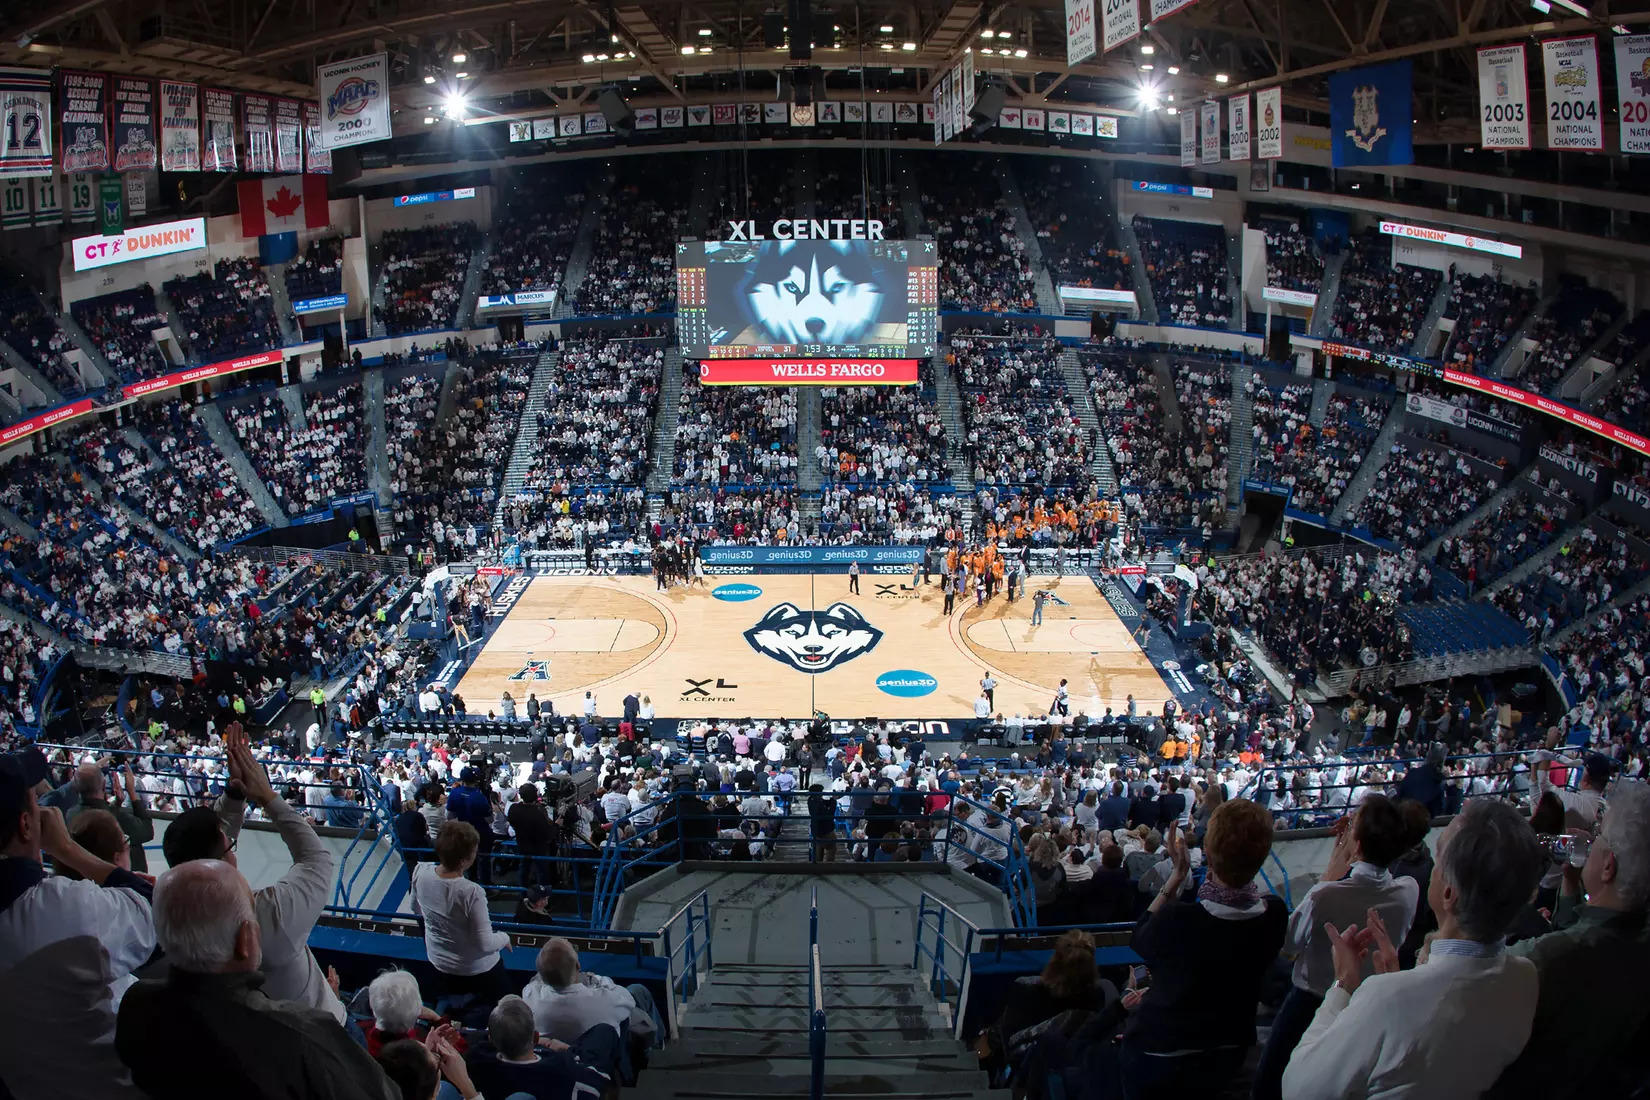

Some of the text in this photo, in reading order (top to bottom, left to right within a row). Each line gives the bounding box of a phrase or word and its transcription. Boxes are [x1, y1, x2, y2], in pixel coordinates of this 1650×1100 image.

[1106, 0, 1131, 15] 20
[1069, 4, 1090, 36] 2014
[1108, 9, 1132, 28] NATIONAL
[1107, 22, 1136, 44] CHAMPIONS
[324, 60, 381, 78] UCONN HOCKEY
[68, 100, 97, 111] SEASON
[327, 80, 380, 121] MAAC
[63, 112, 104, 123] CHAMPIONS
[120, 114, 149, 124] CHAMPIONS
[1485, 104, 1524, 122] 2003
[1551, 101, 1597, 120] 2004
[1623, 102, 1650, 123] 20
[7, 113, 42, 149] 12
[338, 117, 372, 131] 2000
[334, 128, 378, 142] CHAMPIONS
[1231, 132, 1248, 144] 2000
[1260, 127, 1280, 141] 2002
[1554, 138, 1596, 146] CHAMPIONS
[6, 188, 24, 211] 10
[40, 185, 56, 208] 11
[73, 185, 90, 208] 19
[410, 195, 428, 204] pepsi
[728, 219, 884, 240] XL CENTER
[1383, 224, 1446, 241] CT DUNKIN'
[85, 228, 195, 259] CT DUNKIN'
[232, 356, 270, 369] WELLS FARGO
[771, 364, 826, 377] WELLS
[830, 364, 885, 377] FARGO
[182, 368, 218, 380] WELLS FARGO
[1445, 371, 1480, 386] WELLS FARGO
[151, 380, 169, 389] FARGO
[1492, 385, 1524, 400] WELLS FARGO
[1537, 399, 1552, 410] WELLS
[1468, 416, 1493, 431] UCONN
[1573, 413, 1602, 430] WELLS FARGO
[1614, 429, 1646, 448] WELLS FARGO
[1539, 447, 1565, 466] UCONN
[708, 550, 920, 561] genius3D genius3D genius3D genius3D
[486, 576, 531, 616] HUSKIES
[682, 678, 738, 695] XL
